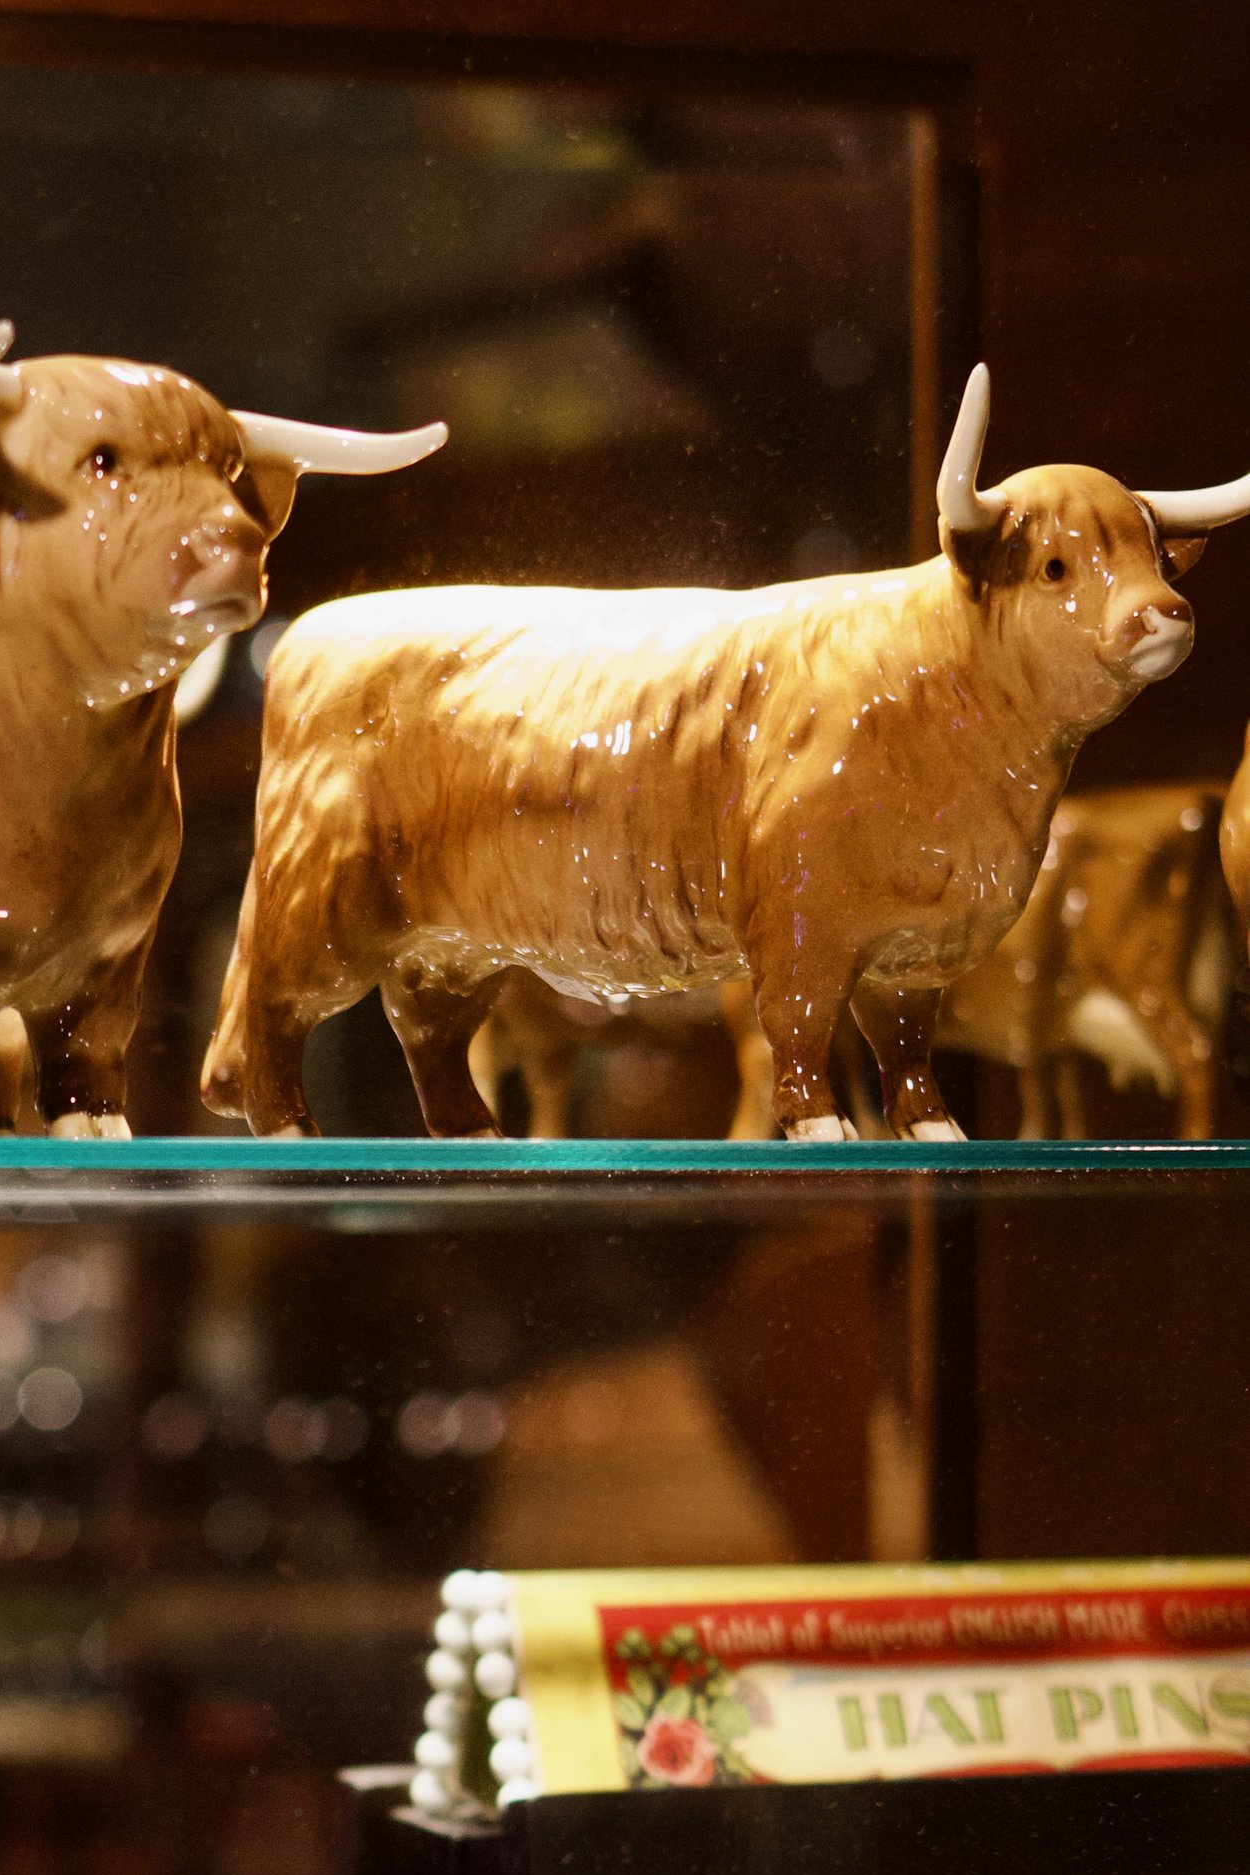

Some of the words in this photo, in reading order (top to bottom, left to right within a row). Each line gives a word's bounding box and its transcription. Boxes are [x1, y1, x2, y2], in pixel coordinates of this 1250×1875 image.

[699, 1612, 785, 1655] Tablet
[791, 1608, 821, 1650] of
[828, 1609, 947, 1662] Superior
[950, 1603, 1061, 1643] ENGLISH
[1064, 1600, 1147, 1642] MADE
[837, 1686, 1010, 1750] HAT
[1048, 1673, 1250, 1744] PINS
